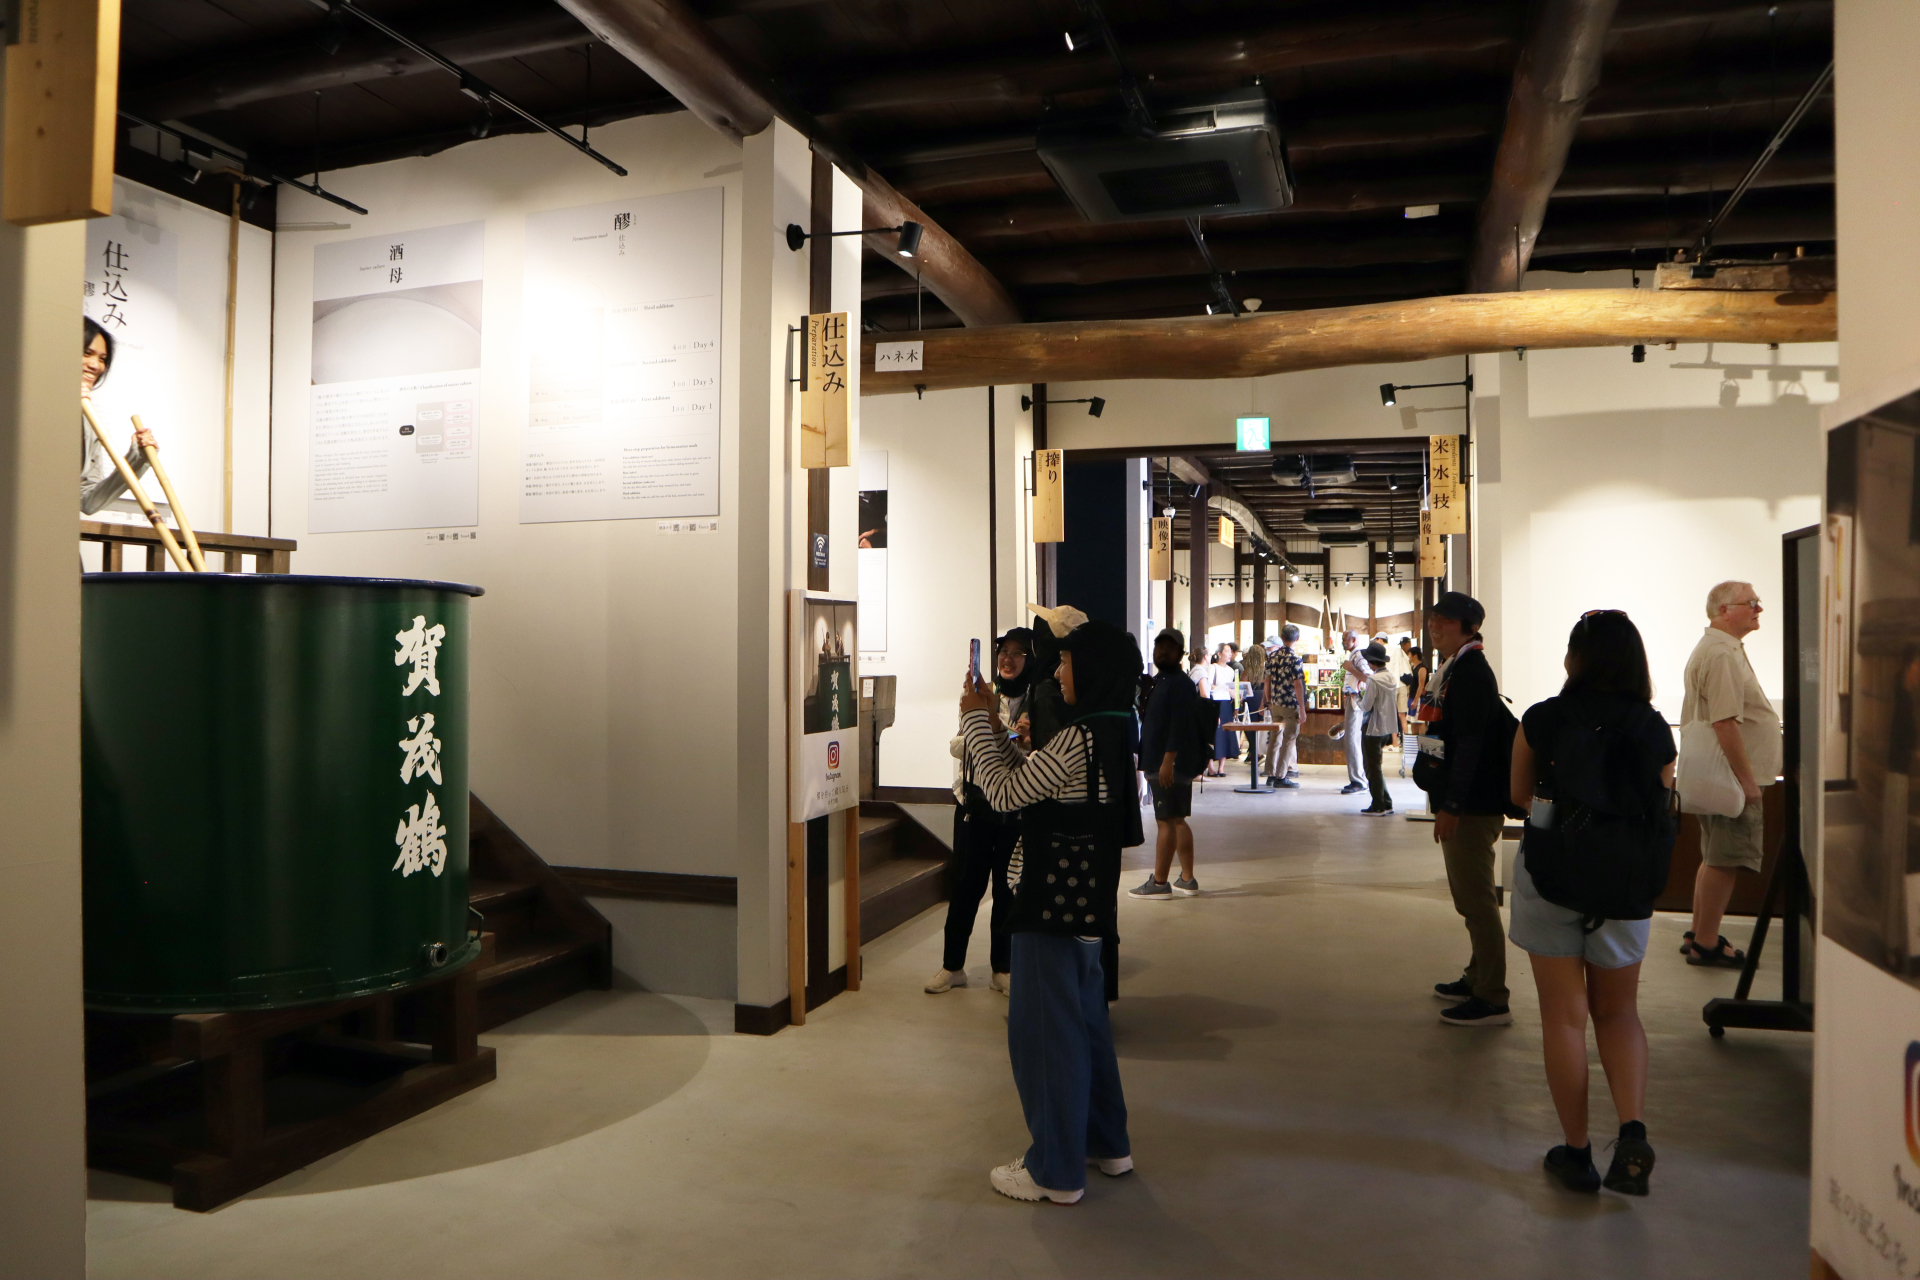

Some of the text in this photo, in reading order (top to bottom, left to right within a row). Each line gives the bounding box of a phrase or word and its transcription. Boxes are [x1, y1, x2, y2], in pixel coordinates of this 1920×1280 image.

[618, 234, 626, 256] 仕込み
[389, 243, 404, 284] 酒母
[102, 240, 130, 328] 仕込み
[693, 341, 708, 350] Day
[809, 319, 819, 367] Preparation
[822, 317, 845, 395] 仕込み
[879, 349, 918, 363] ハネ木
[693, 379, 707, 387] Day
[691, 404, 706, 412] Day
[1046, 452, 1060, 484] 搾り
[1433, 438, 1450, 509] 米 水 技
[1158, 520, 1169, 551] 映像2
[392, 615, 447, 878] 賀茂鶴
